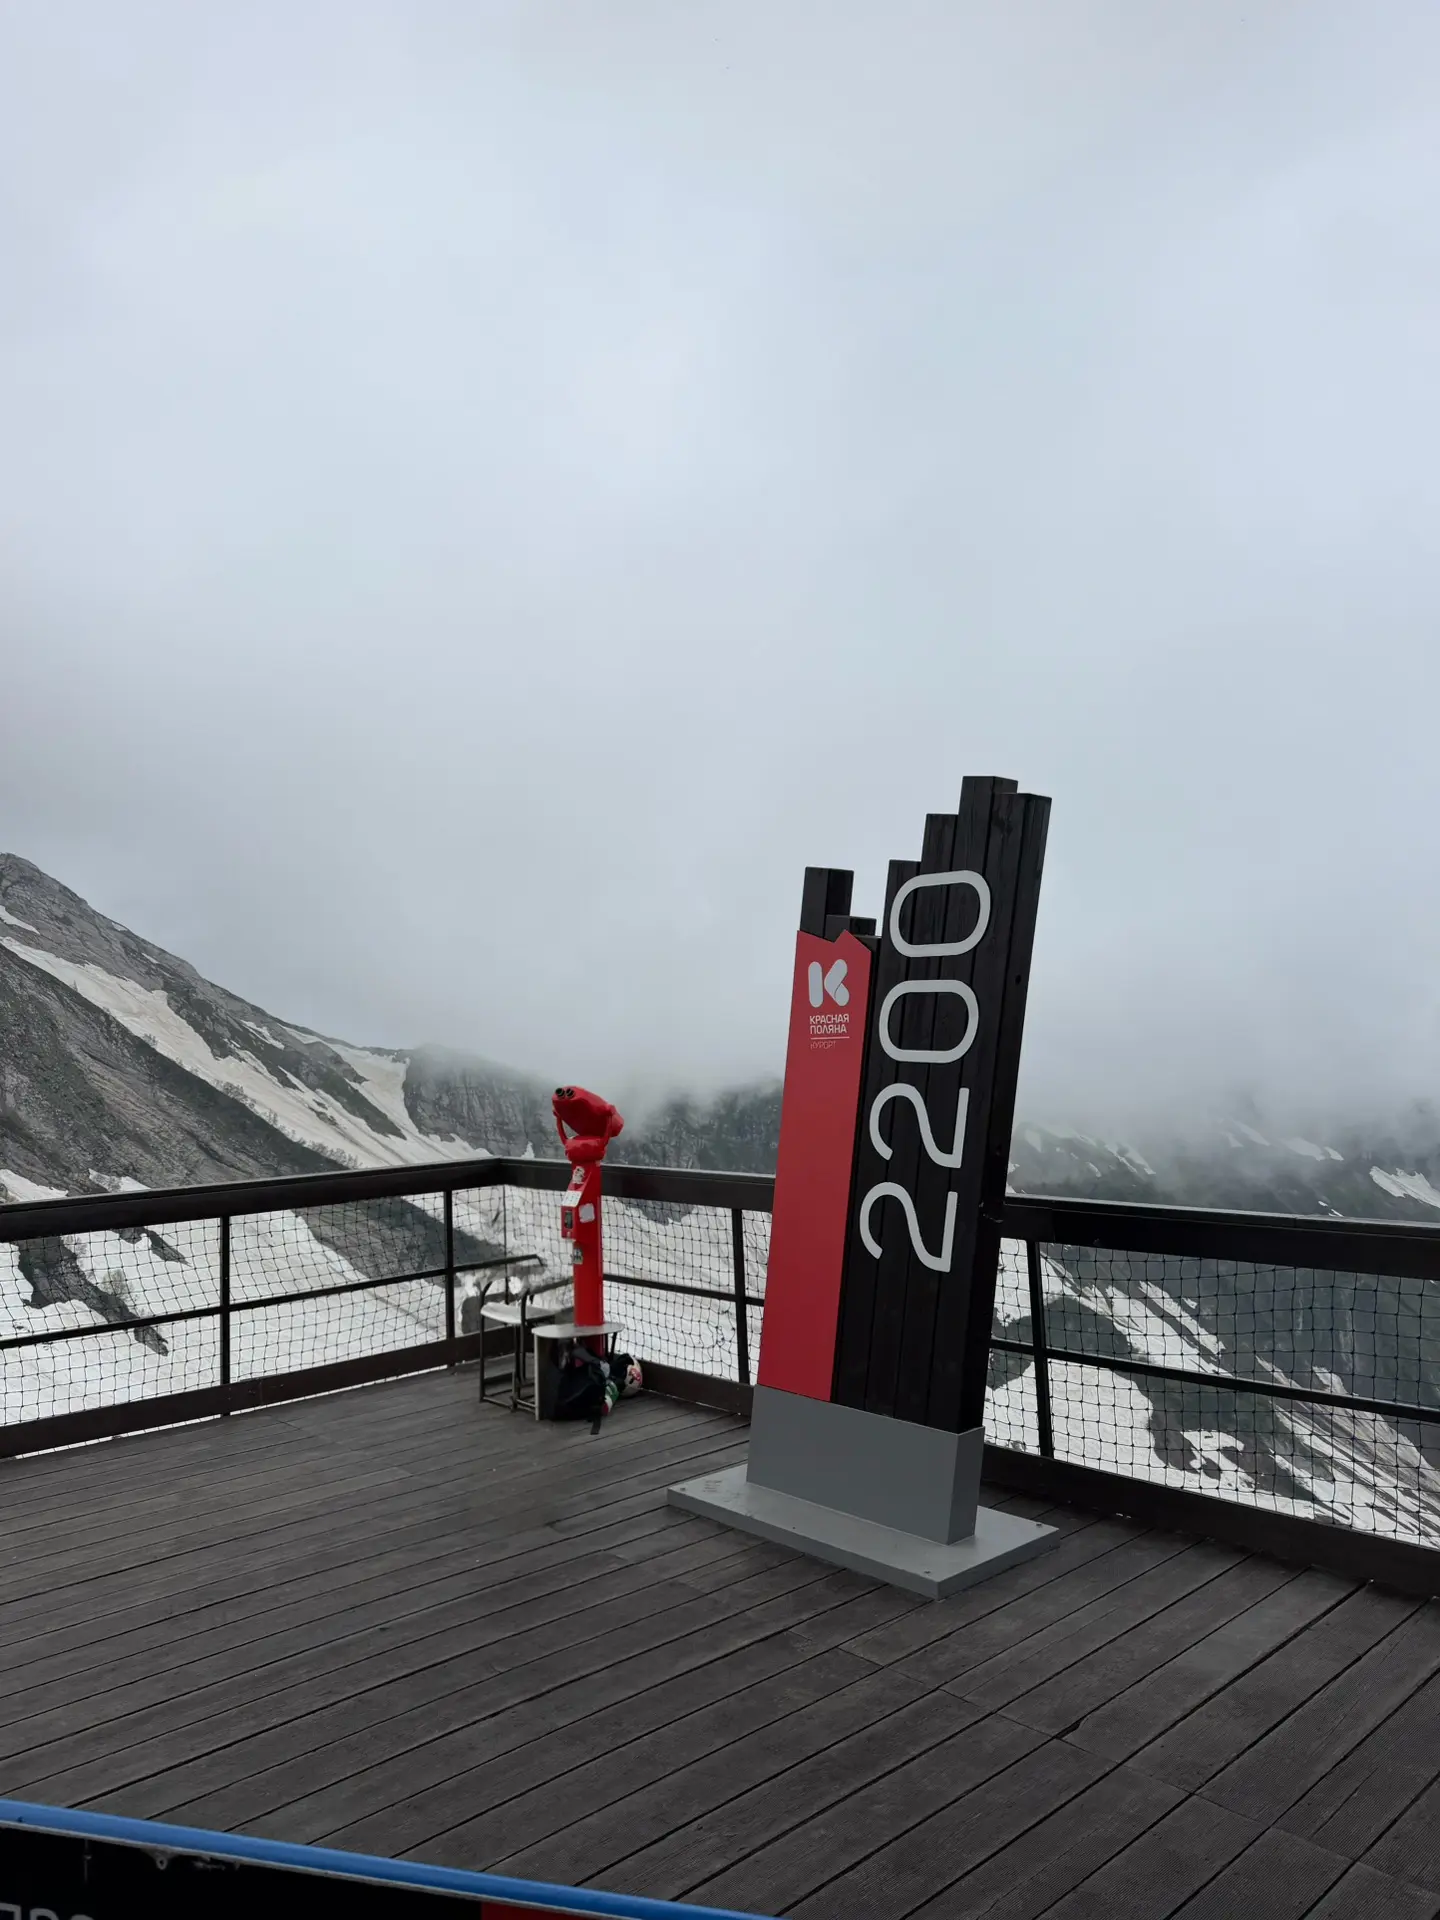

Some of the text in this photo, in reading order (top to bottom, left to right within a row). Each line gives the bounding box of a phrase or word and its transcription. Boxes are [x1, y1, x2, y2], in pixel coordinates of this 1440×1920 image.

[809, 1013, 849, 1024] КРАСНАЯ
[810, 1024, 847, 1035] ПОЛЯНА
[860, 870, 991, 1272] 2200
